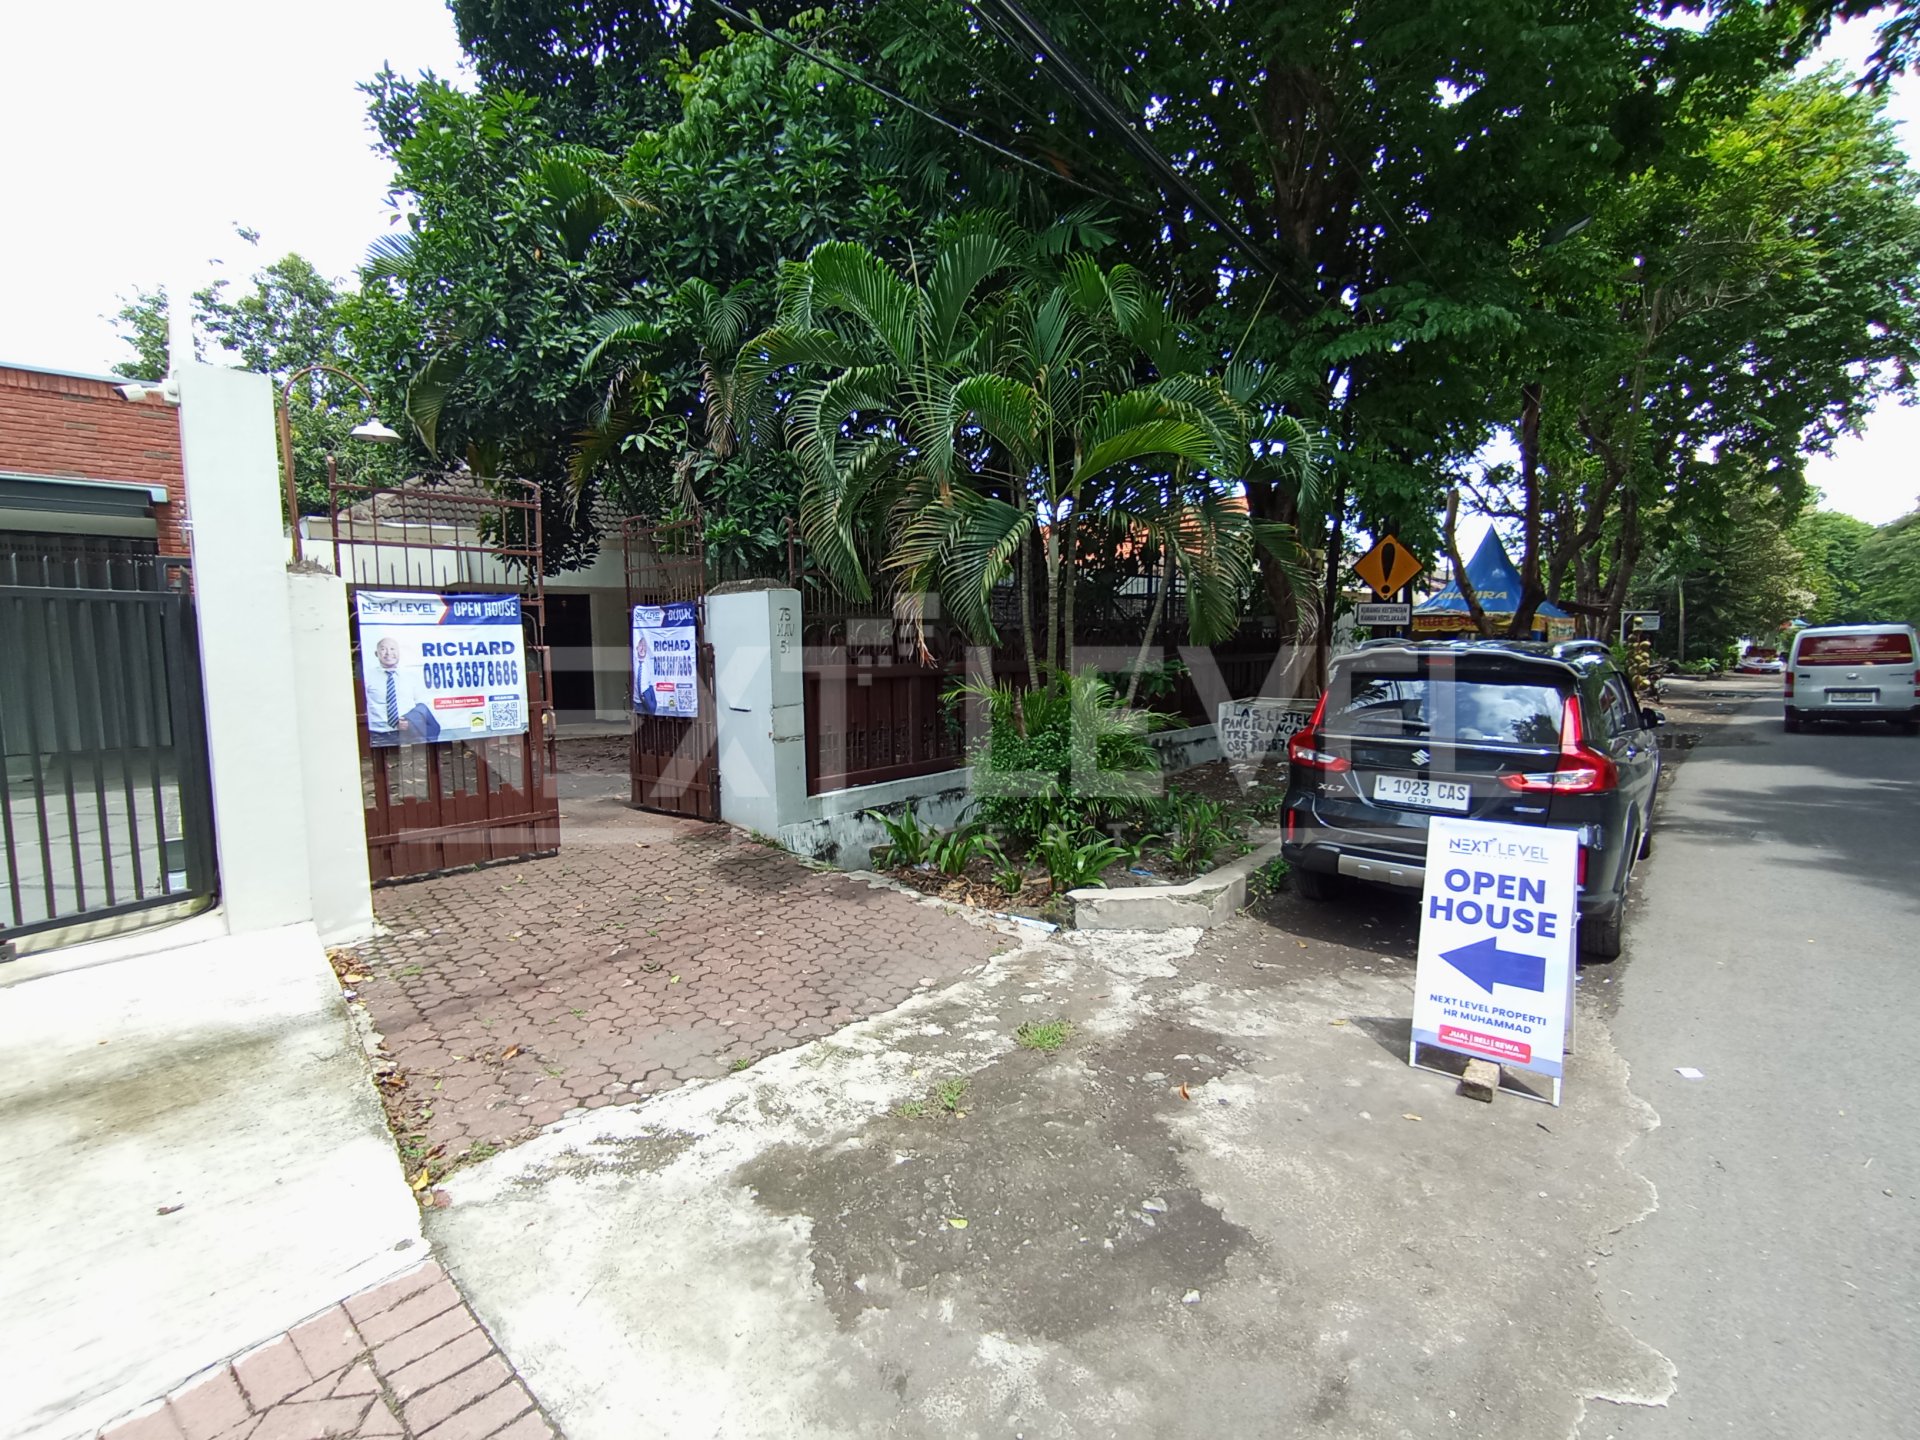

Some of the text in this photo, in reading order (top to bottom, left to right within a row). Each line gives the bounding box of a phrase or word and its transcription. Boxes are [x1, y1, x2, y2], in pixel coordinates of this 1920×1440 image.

[362, 601, 437, 613] NEXT LEVEL
[453, 600, 518, 617] OPEN HOUSE
[778, 607, 792, 622] 75
[422, 640, 516, 657] RICHARD
[653, 639, 691, 652] RICHARD
[424, 659, 519, 690] 0813 3687 8686
[1317, 782, 1345, 793] XL7
[1378, 777, 1467, 802] L 1923 CAS
[1449, 838, 1489, 854] NEXT
[1498, 843, 1549, 861] LEVEL
[1444, 868, 1547, 905] OPEN
[1429, 895, 1558, 939] HOUSE
[1429, 993, 1547, 1027] NEXT LEVEL PROPERTI
[1443, 1007, 1532, 1035] HR MUHAMMAD
